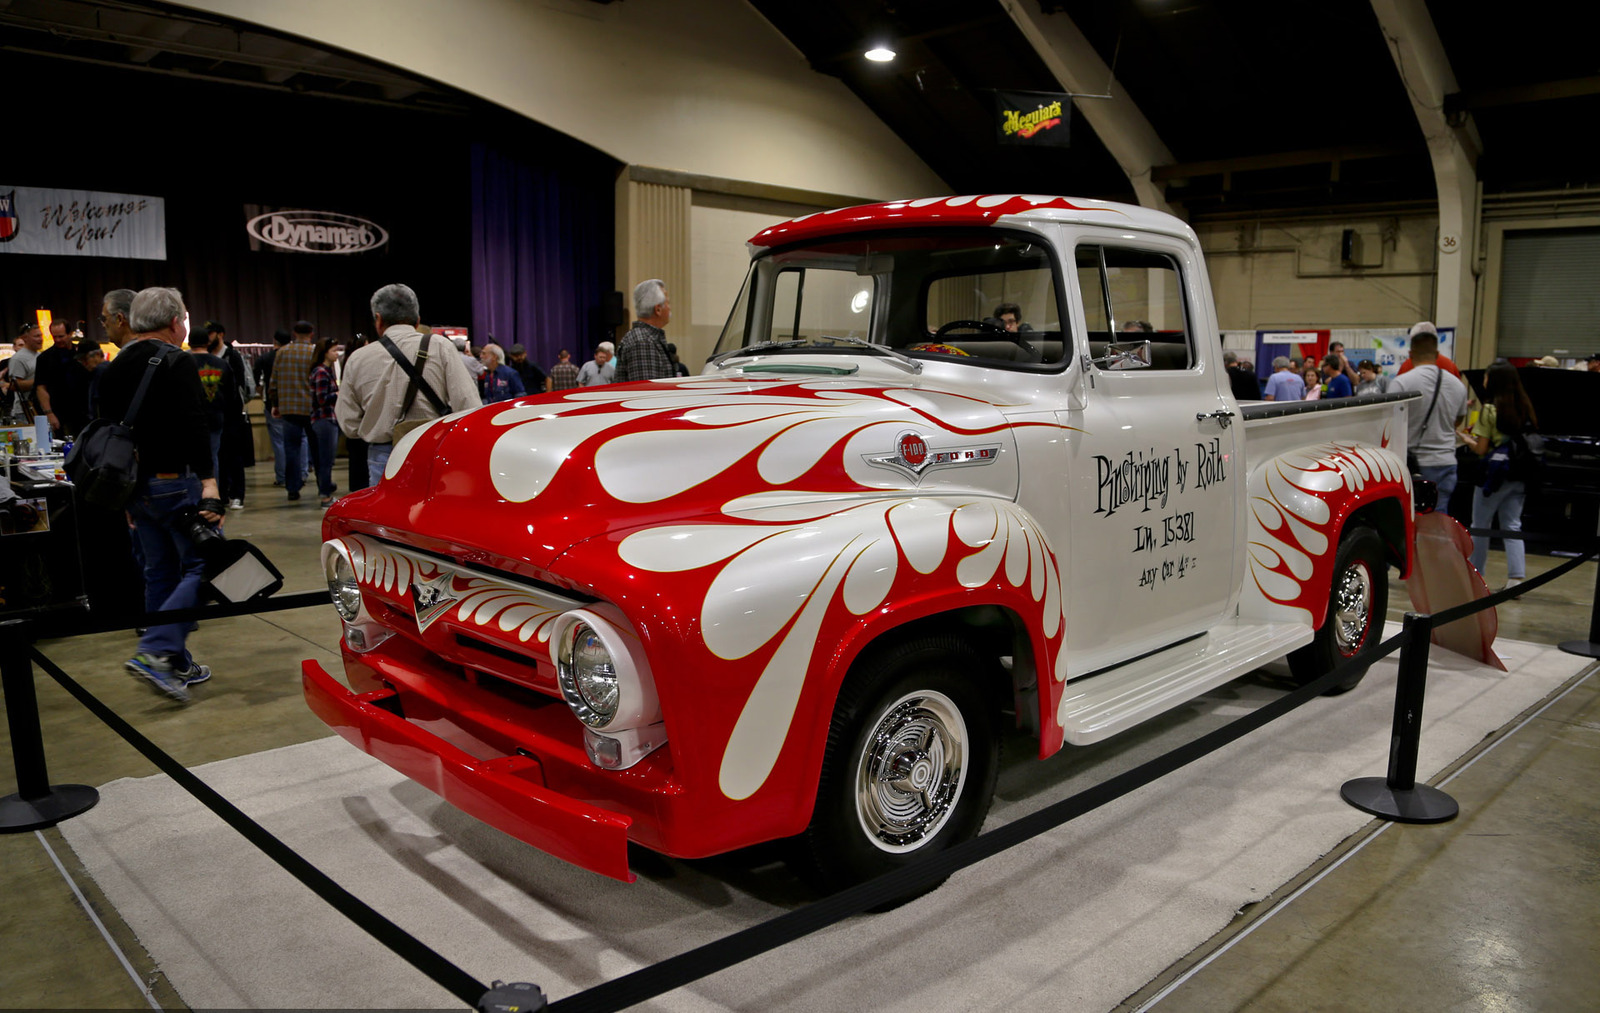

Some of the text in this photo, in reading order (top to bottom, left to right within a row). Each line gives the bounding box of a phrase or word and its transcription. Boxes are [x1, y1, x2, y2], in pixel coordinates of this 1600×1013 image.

[1003, 100, 1062, 135] Meguiar's
[64, 219, 122, 250] You!
[271, 215, 368, 246] Dynamat
[1443, 236, 1456, 247] 36
[902, 442, 924, 456] F-100
[936, 449, 989, 462] FORD
[1091, 438, 1226, 518] Pinstriping by Roth
[1138, 568, 1159, 591] Any
